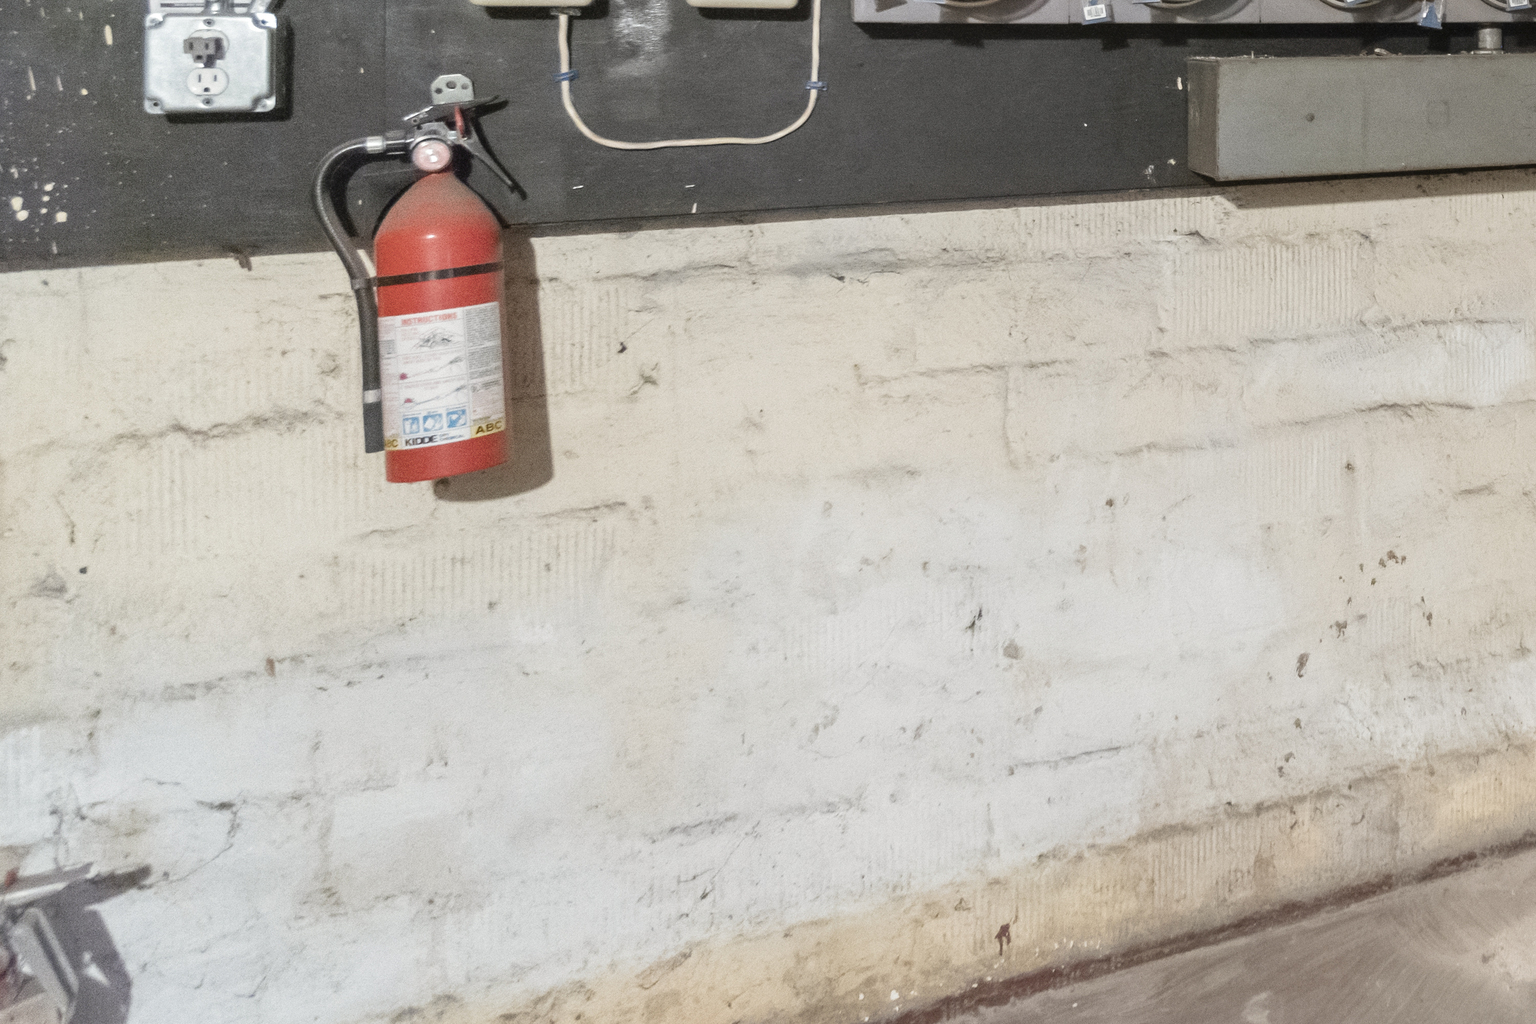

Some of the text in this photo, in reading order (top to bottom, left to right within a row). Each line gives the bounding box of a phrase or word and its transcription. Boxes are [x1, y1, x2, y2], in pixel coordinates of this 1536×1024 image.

[401, 312, 457, 326] INSTRUCTIONS
[475, 420, 502, 435] ABC
[405, 434, 438, 447] KIDDE
